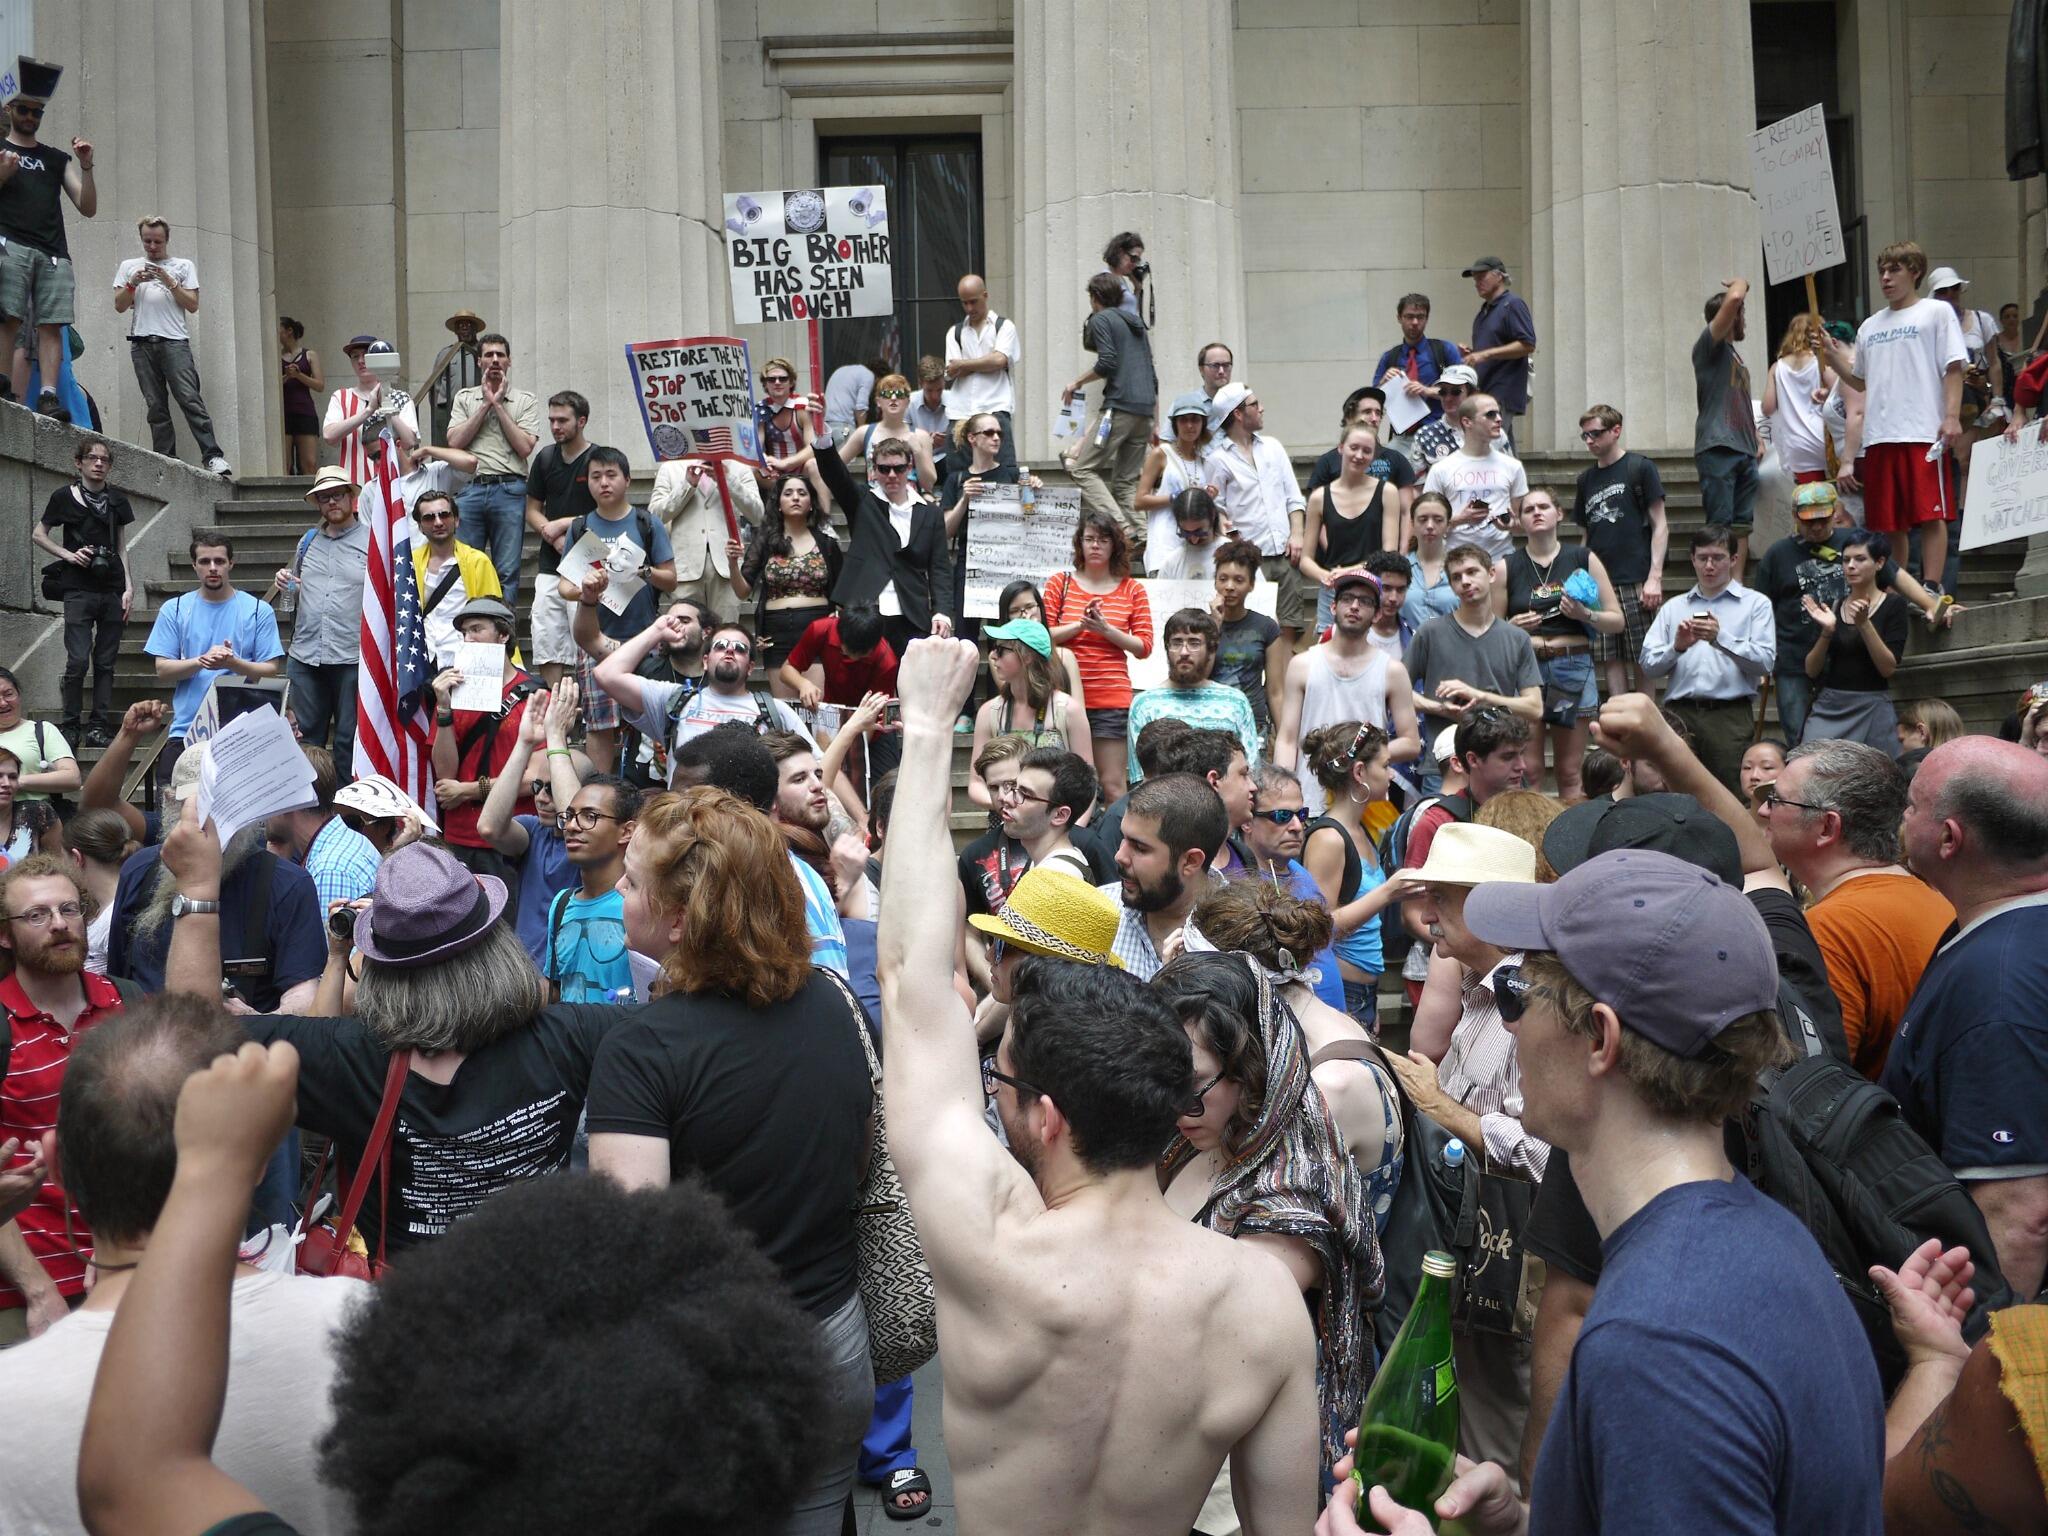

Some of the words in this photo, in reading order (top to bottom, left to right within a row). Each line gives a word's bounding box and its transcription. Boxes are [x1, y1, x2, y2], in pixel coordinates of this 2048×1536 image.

[1768, 106, 1820, 146] REFUSE
[732, 238, 792, 268] BIG
[806, 233, 891, 264] BROTHER
[754, 266, 803, 296] HAS
[810, 264, 865, 291] SEEN
[761, 291, 852, 323] ENOUGH
[1868, 330, 1888, 341] RON
[1891, 326, 1919, 336] PAUL
[637, 347, 709, 371] RESTORE
[710, 346, 732, 365] THE
[690, 369, 722, 391] THE
[721, 367, 749, 391] LYING
[691, 396, 724, 418] THE
[723, 394, 753, 419] SPYING
[494, 1119, 505, 1128] the
[536, 1090, 567, 1108] thousands
[509, 1115, 528, 1126] These
[408, 1221, 447, 1235] DRIVE
[895, 1469, 915, 1481] NIKE
